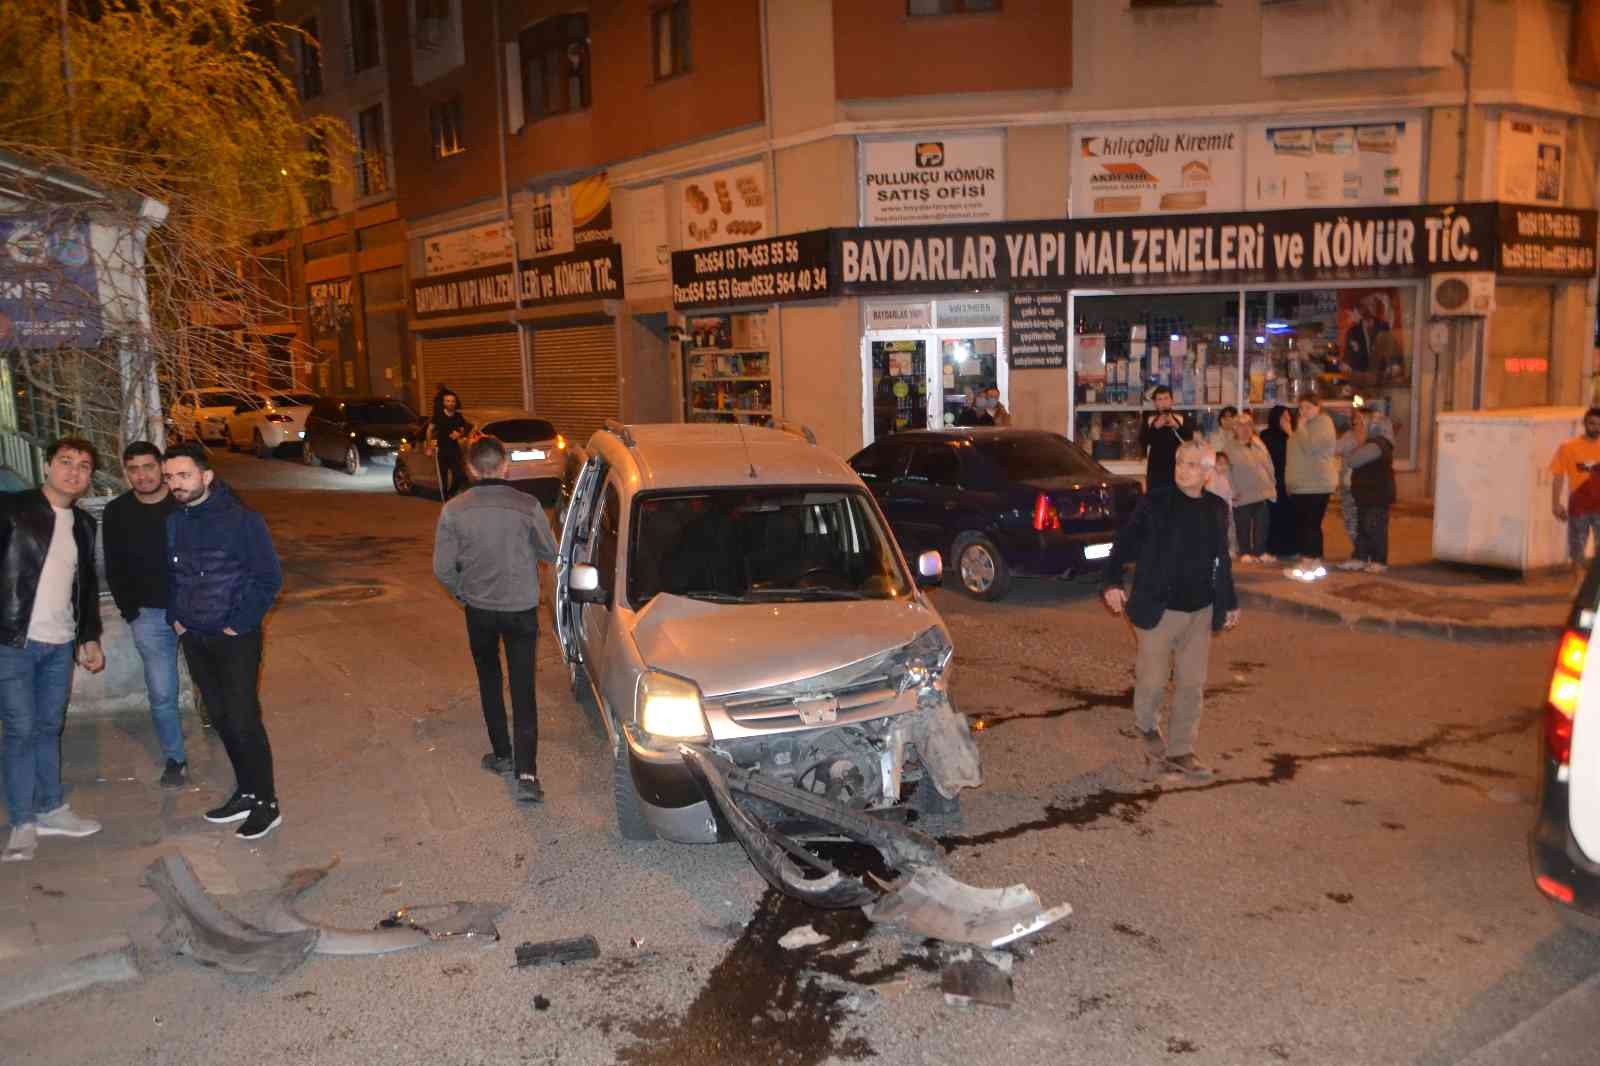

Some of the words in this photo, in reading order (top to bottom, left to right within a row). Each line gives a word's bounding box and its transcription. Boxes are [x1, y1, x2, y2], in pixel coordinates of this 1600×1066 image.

[866, 171, 940, 186] PULLUKÇU
[944, 166, 995, 183] KÖMÜR
[877, 187, 930, 202] SATIŞ
[771, 241, 784, 265] 55
[785, 239, 799, 263] 56
[842, 235, 997, 283] BAYDARLAR
[1006, 231, 1066, 278] YAPI
[1273, 231, 1304, 270] ve
[1312, 215, 1416, 268] KÖMÜR
[705, 280, 717, 301] 55
[718, 278, 730, 300] 53
[797, 269, 811, 292] 40
[813, 266, 827, 291] 34
